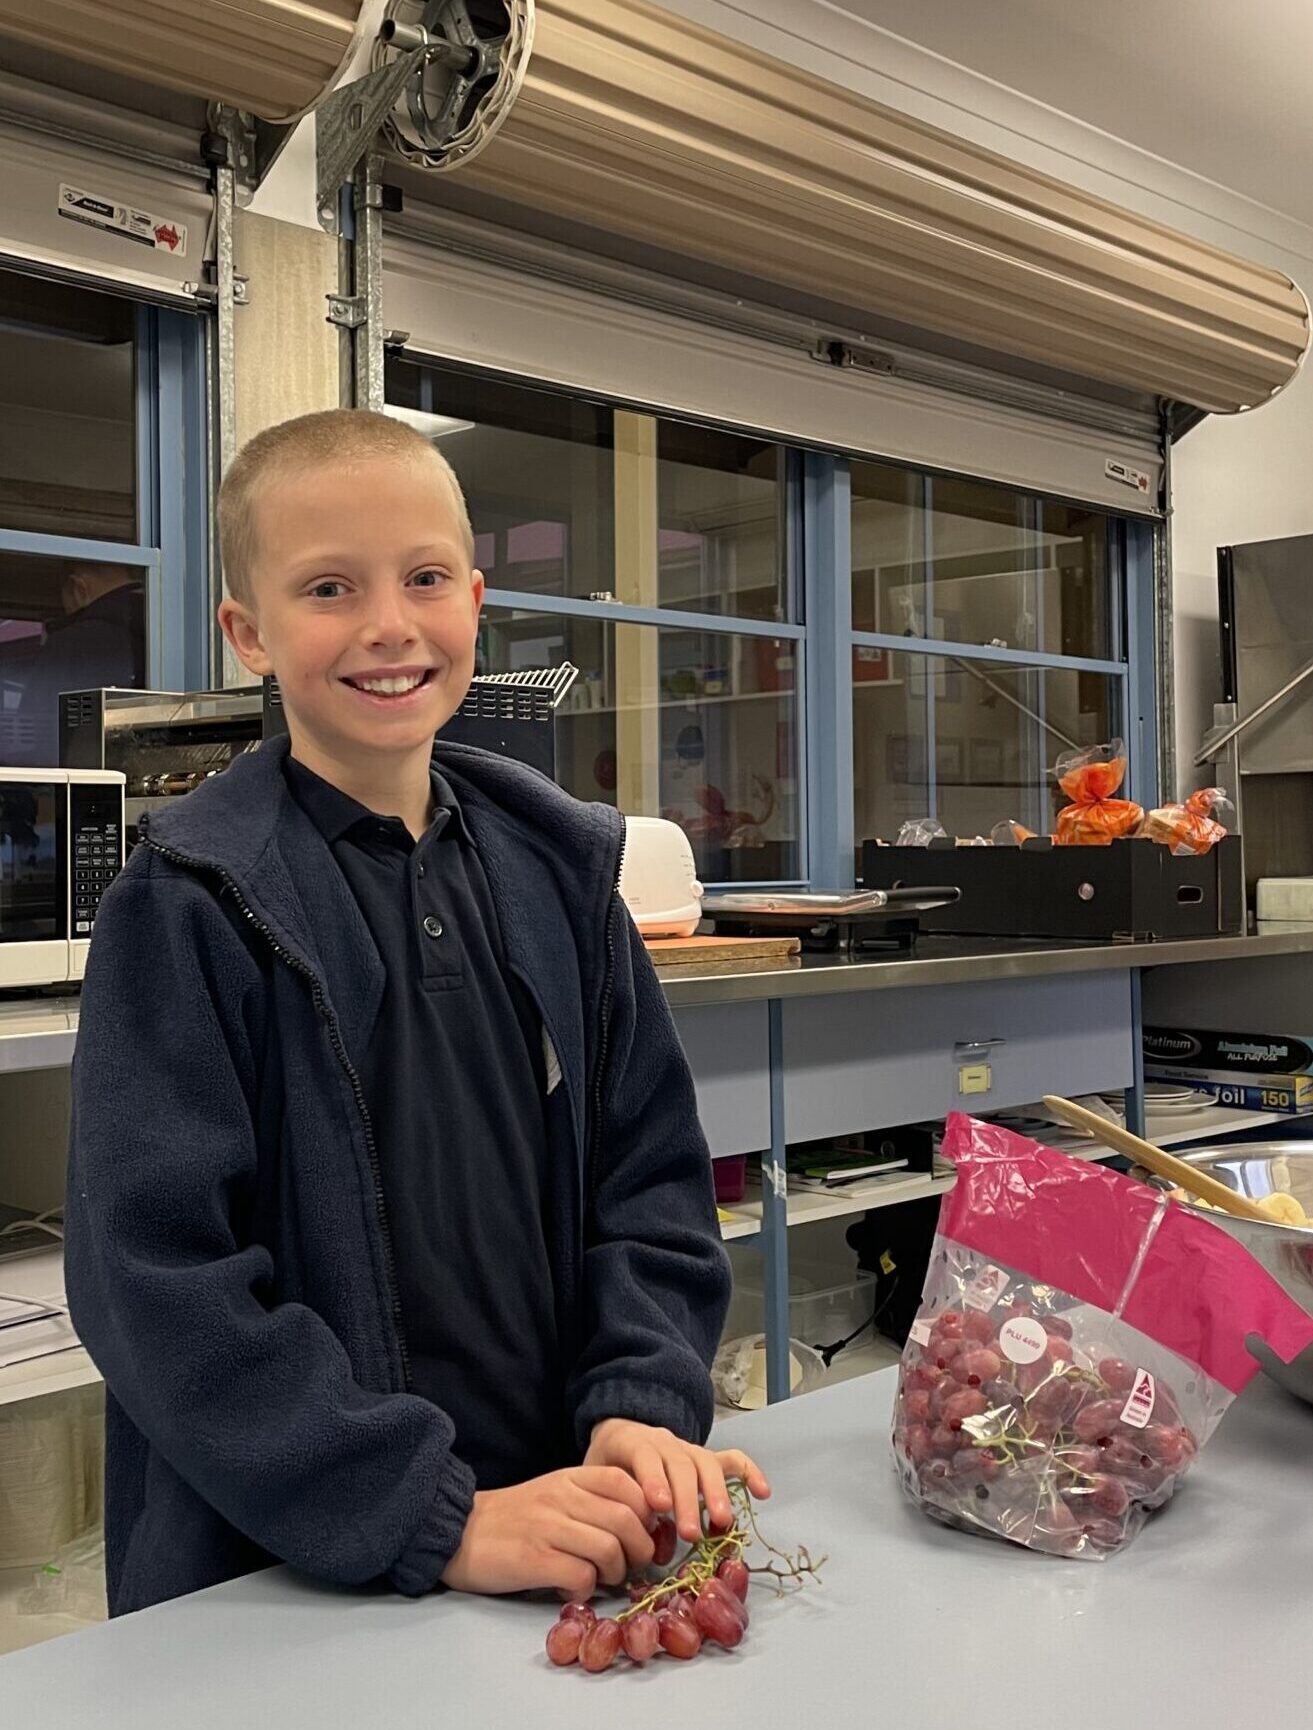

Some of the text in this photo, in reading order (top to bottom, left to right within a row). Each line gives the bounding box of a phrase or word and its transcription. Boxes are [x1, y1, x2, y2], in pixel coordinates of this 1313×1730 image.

[1227, 1052, 1243, 1061] ALL
[1262, 1090, 1289, 1107] 150
[1006, 1327, 1022, 1341] PLU
